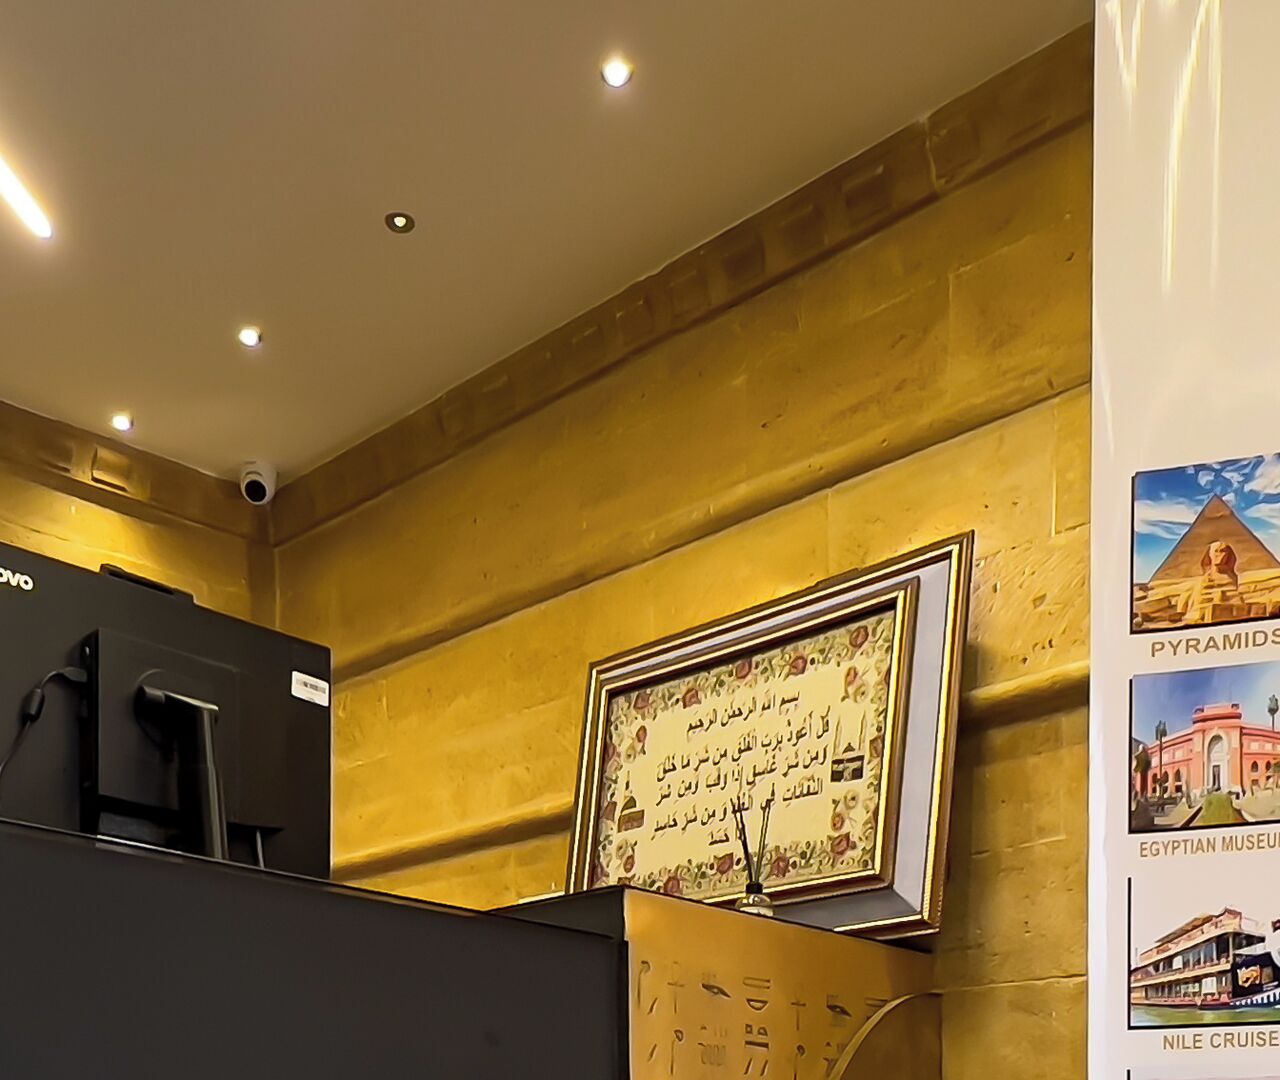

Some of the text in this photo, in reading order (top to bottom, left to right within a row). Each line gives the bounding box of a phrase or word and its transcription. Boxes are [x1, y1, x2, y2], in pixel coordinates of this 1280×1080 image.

[1139, 836, 1216, 858] EGYPTIAN
[1163, 1030, 1280, 1050] NILE CRUISE
